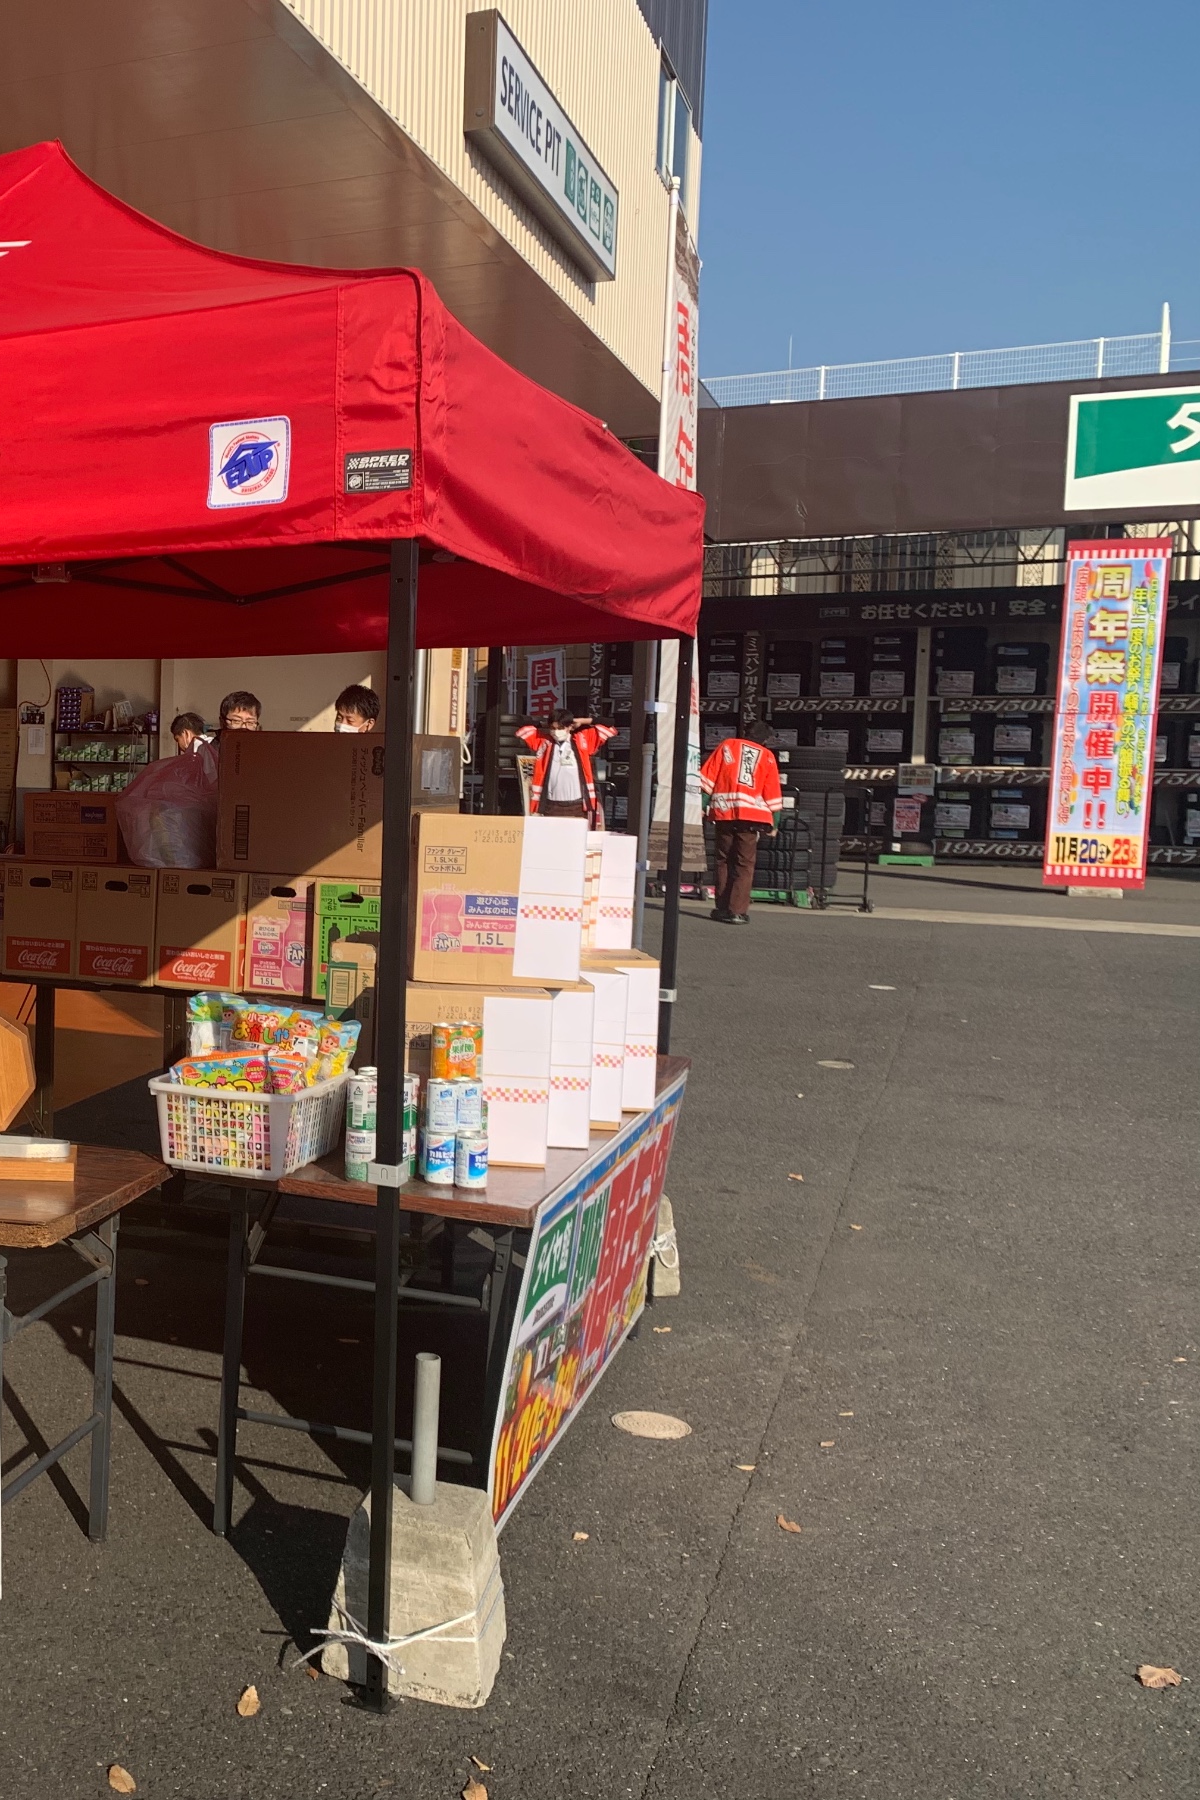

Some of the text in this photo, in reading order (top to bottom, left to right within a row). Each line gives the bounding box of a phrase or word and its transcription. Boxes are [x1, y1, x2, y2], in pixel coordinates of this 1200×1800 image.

[500, 55, 561, 176] SERVICE PIT
[360, 454, 410, 464] SPEED
[476, 897, 509, 905] 遊び心は
[468, 906, 517, 916] みんなの中に
[433, 937, 460, 949] FANTA
[18, 949, 57, 966] Coca-Cola
[92, 955, 134, 973] Coca-Cola
[172, 959, 216, 977] Coca-Cola
[247, 1012, 279, 1027] 小さな
[532, 1217, 574, 1297] タイヤ館
